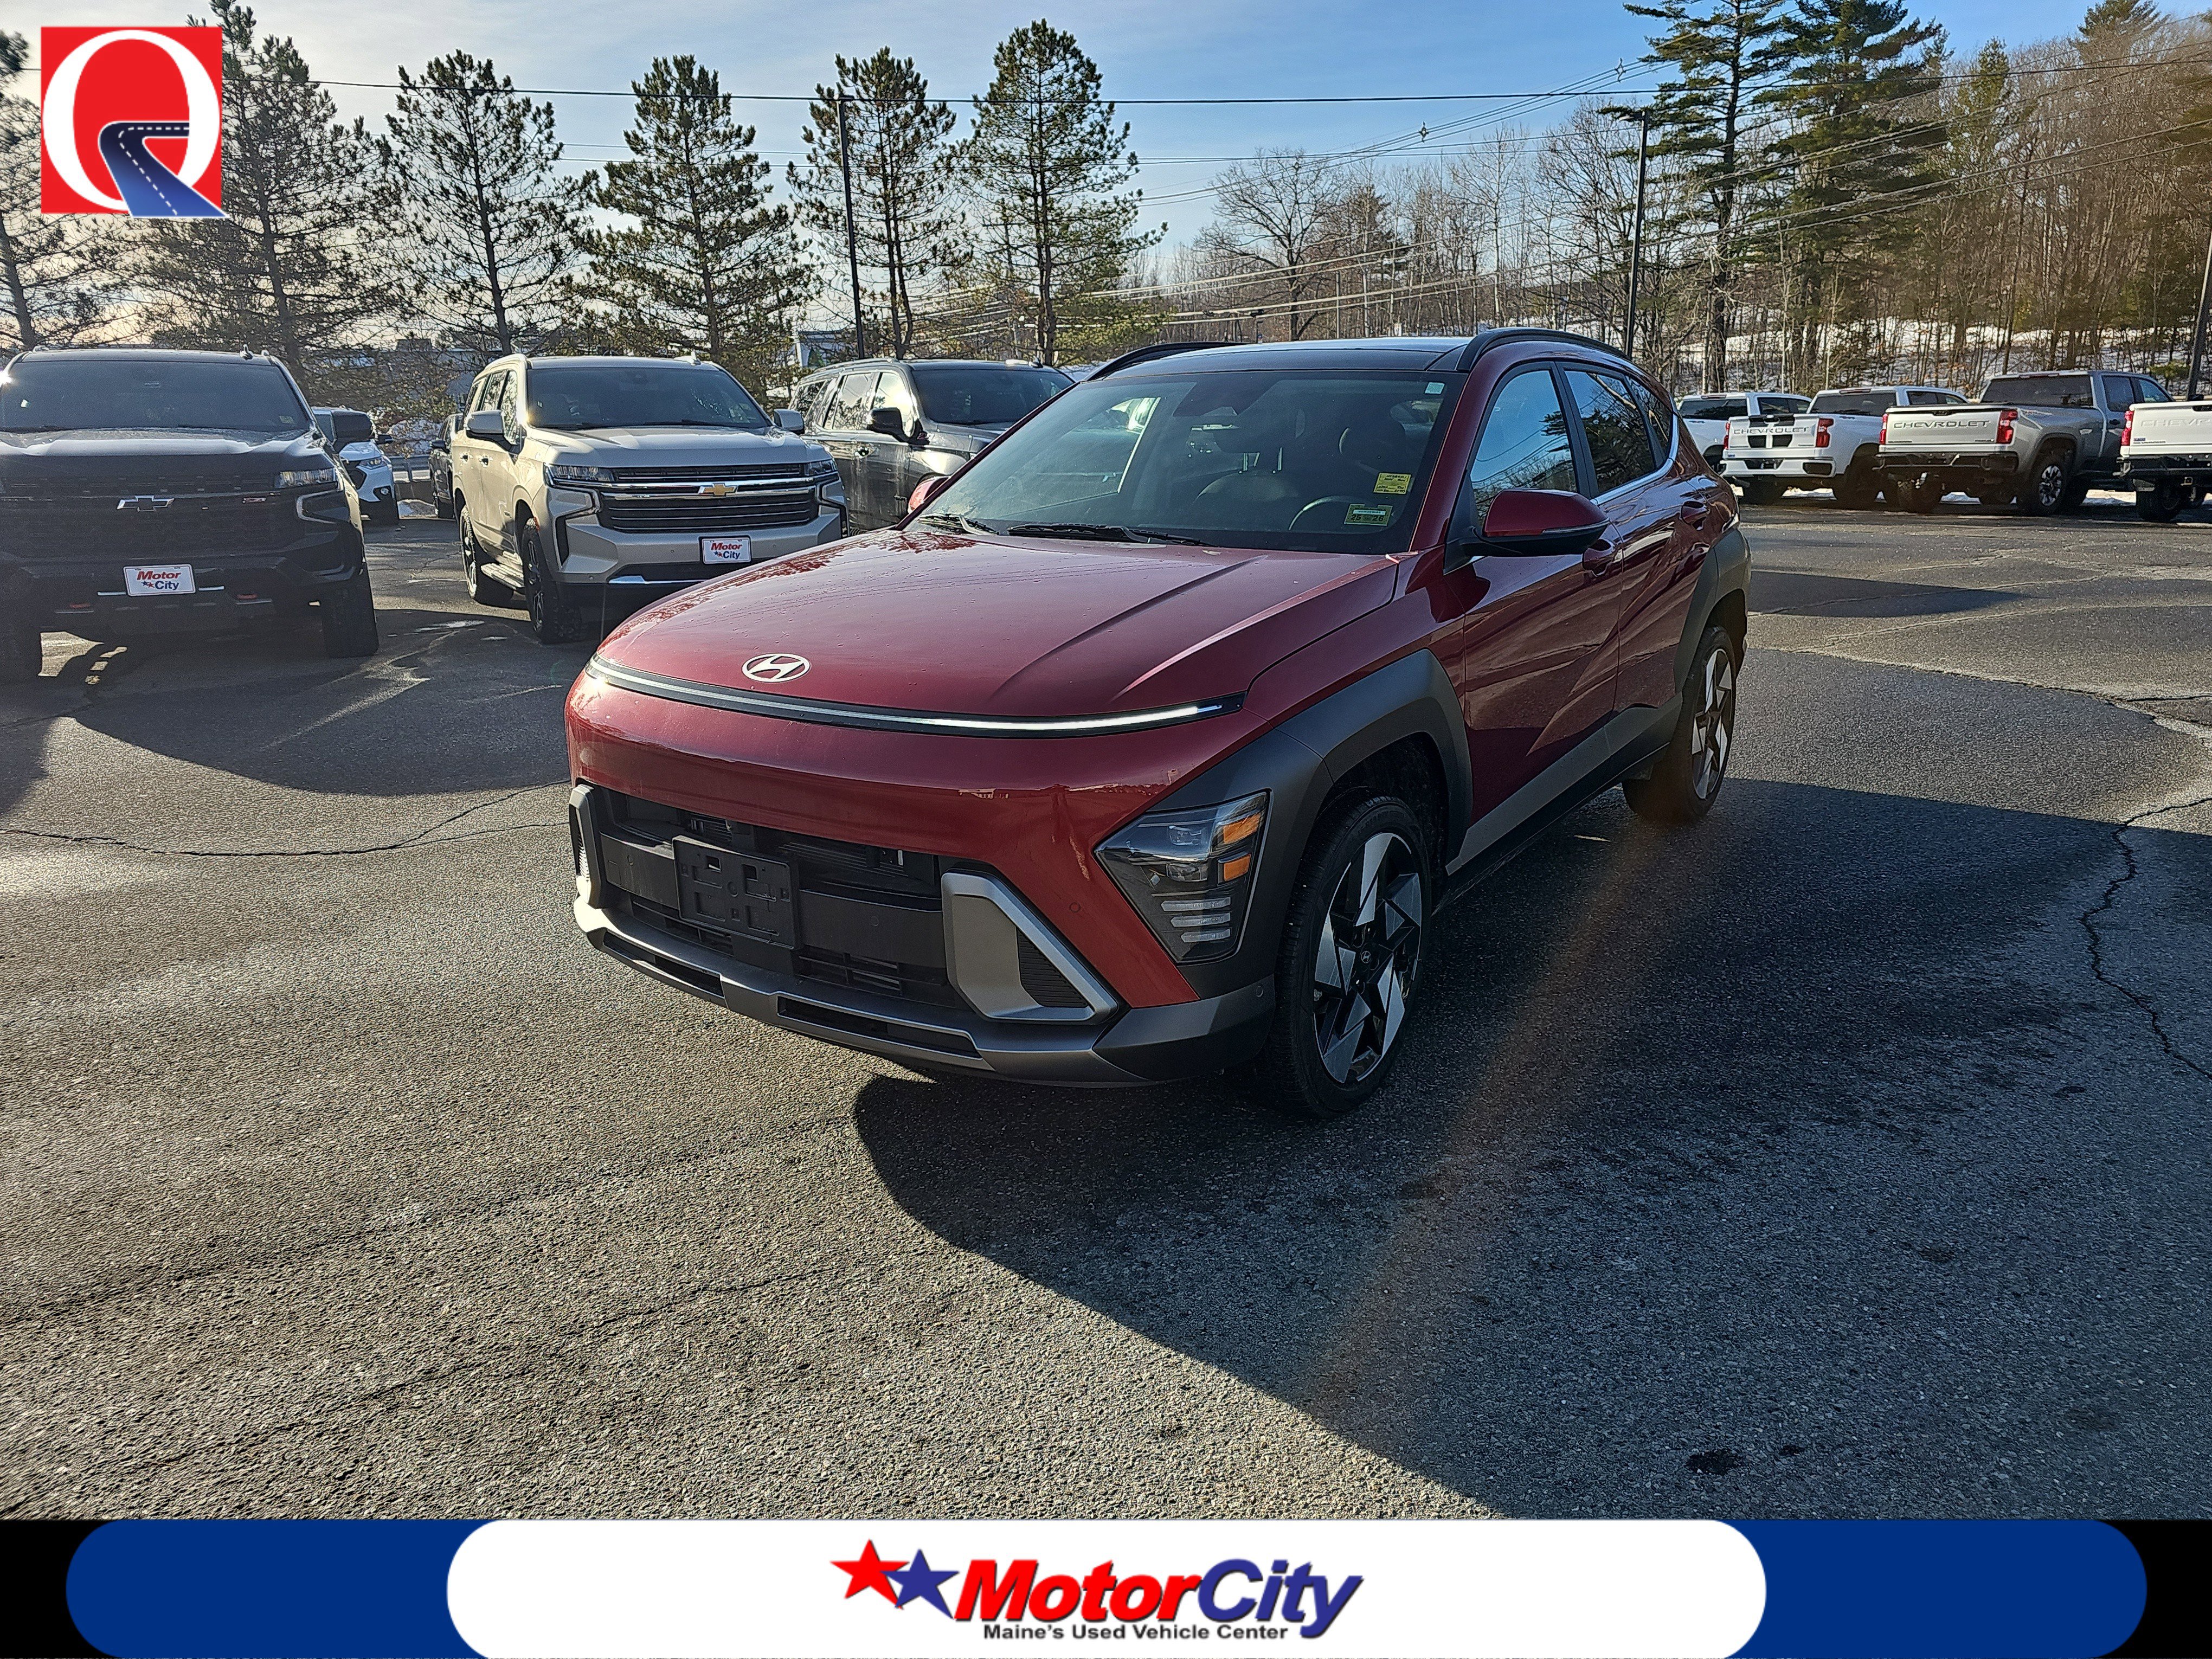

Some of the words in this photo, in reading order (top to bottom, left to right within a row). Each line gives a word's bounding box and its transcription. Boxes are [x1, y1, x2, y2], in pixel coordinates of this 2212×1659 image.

[1894, 420, 1990, 428] CHEVROLET
[711, 542, 742, 550] Motor
[723, 551, 741, 560] City
[136, 571, 181, 580] Motor
[155, 581, 179, 590] City
